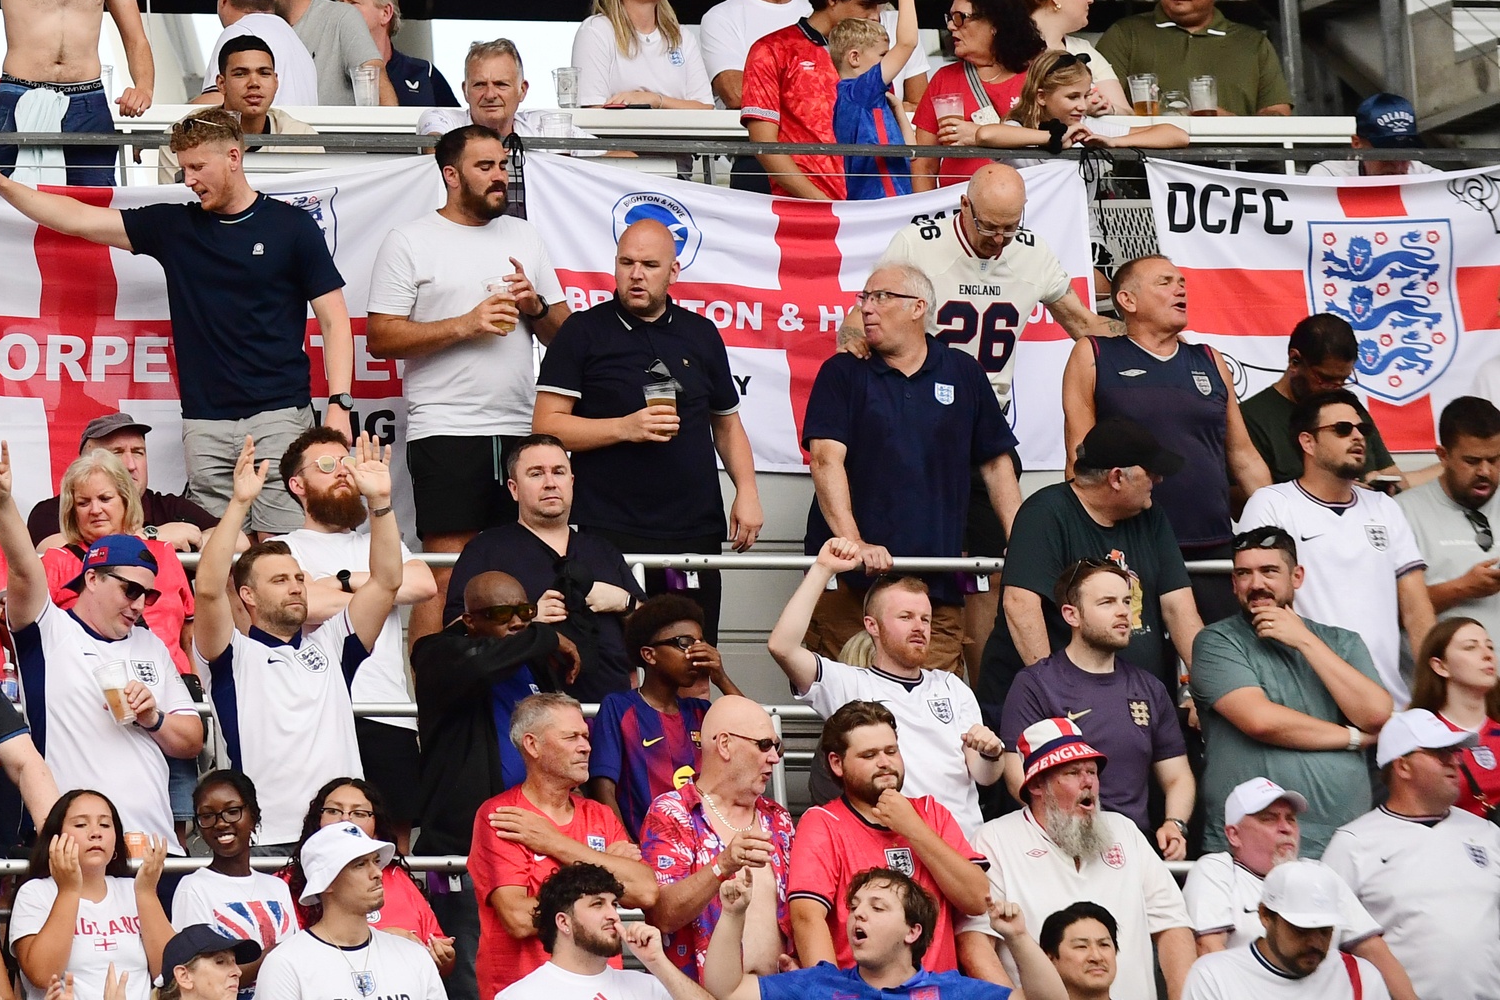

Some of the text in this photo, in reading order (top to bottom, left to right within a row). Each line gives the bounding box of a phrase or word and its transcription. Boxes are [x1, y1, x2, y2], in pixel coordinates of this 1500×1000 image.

[1377, 111, 1414, 126] ORLANDO
[660, 198, 668, 206] &
[666, 201, 686, 219] HOVE
[1167, 181, 1294, 235] DCFC
[1016, 226, 1035, 247] 2
[959, 284, 1001, 296] ENGLAND
[565, 286, 763, 331] BRTON
[777, 302, 805, 332] &
[935, 300, 1020, 373] 26
